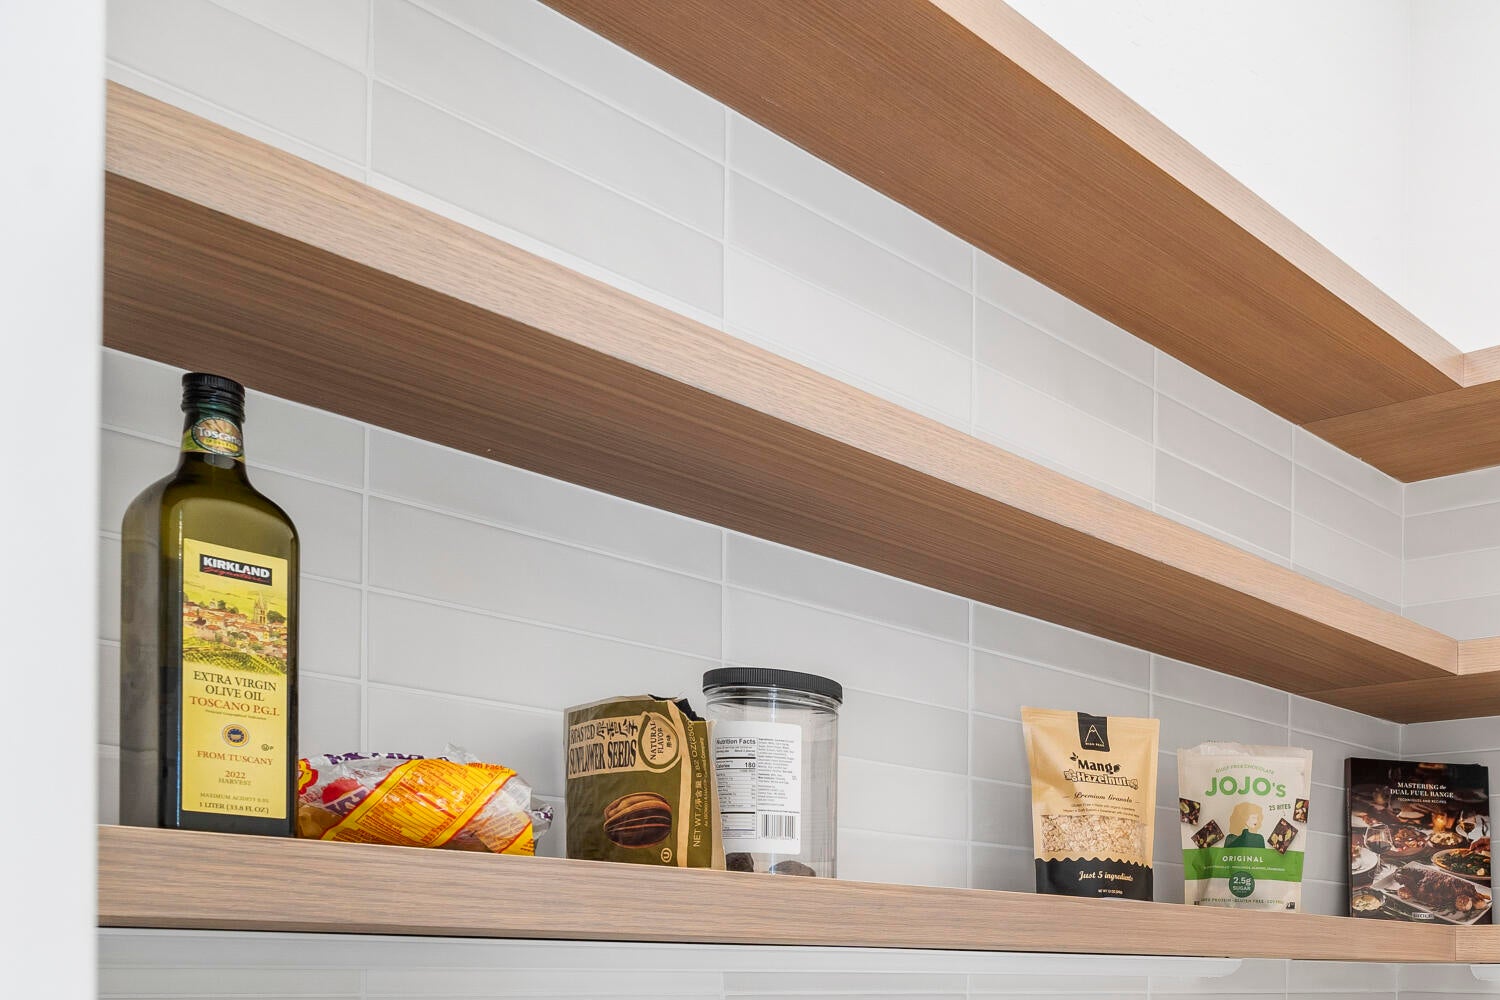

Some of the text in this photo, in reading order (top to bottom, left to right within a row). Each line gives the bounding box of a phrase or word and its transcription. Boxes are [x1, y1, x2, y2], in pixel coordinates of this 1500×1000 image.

[203, 556, 270, 578] KIRKLAND
[193, 671, 276, 691] EXTRA VIRGIN
[205, 684, 264, 701] OLIVE OIL
[189, 696, 250, 712] TOSCANO
[196, 750, 273, 765] FROM TUSCANY
[569, 739, 637, 775] SUNFLOWER SEEDS
[1078, 759, 1121, 774] Mango
[225, 771, 246, 779] 2022
[1076, 771, 1129, 786] Hazelnut
[1205, 775, 1287, 798] JOJO's
[1390, 788, 1410, 796] DUAL
[1397, 781, 1439, 790] MASTERING
[1074, 791, 1133, 803] Premium Granola
[1276, 803, 1292, 811] BITES
[693, 830, 701, 847] NET
[1222, 855, 1264, 863] ORIGINAL
[1079, 870, 1134, 881] Just 5 ingredients
[1232, 876, 1251, 886] 2.5g
